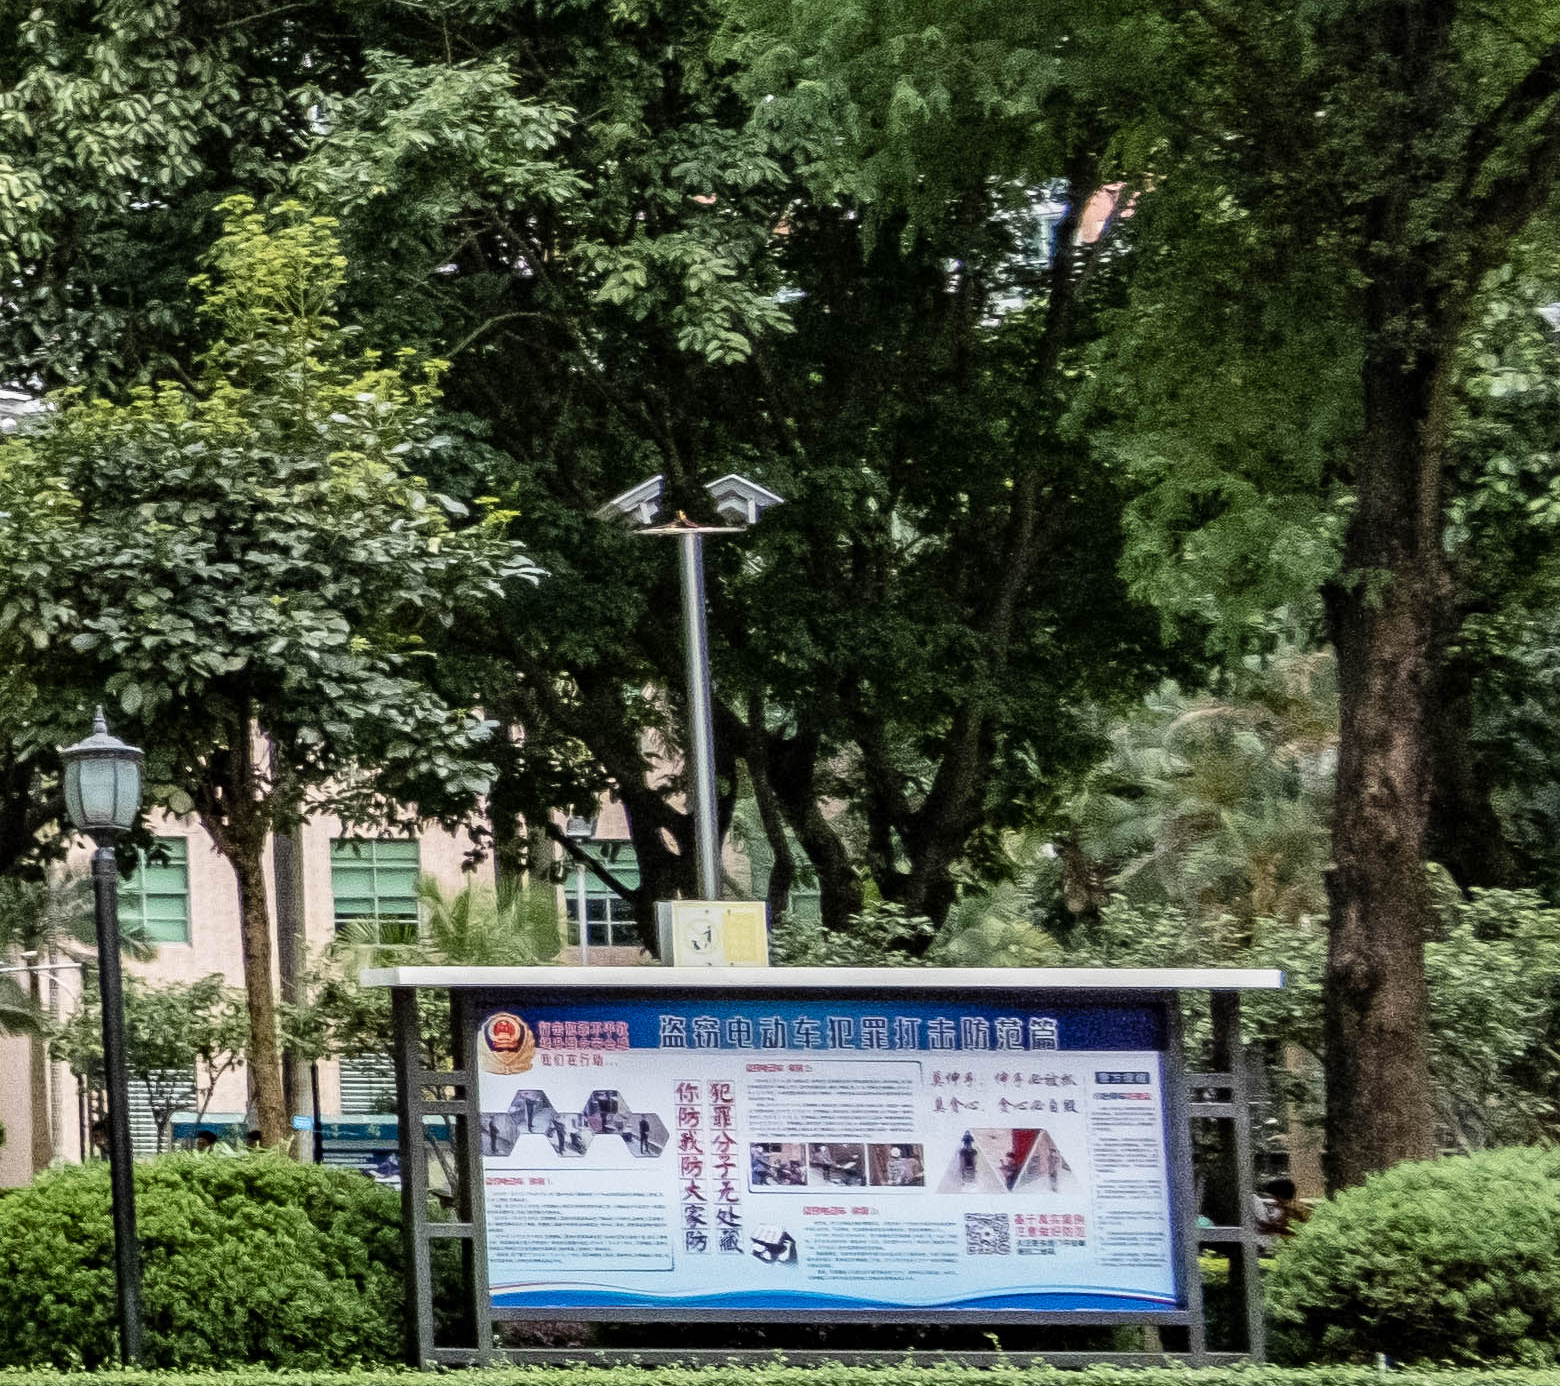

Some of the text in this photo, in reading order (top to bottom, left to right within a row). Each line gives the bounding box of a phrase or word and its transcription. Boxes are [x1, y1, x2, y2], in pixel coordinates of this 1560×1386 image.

[659, 1015, 1058, 1050] 盗窃电动车犯罪打击防范篇
[676, 1082, 708, 1253] 你防我防大家防
[711, 1082, 744, 1254] 犯罪分子无处藏
